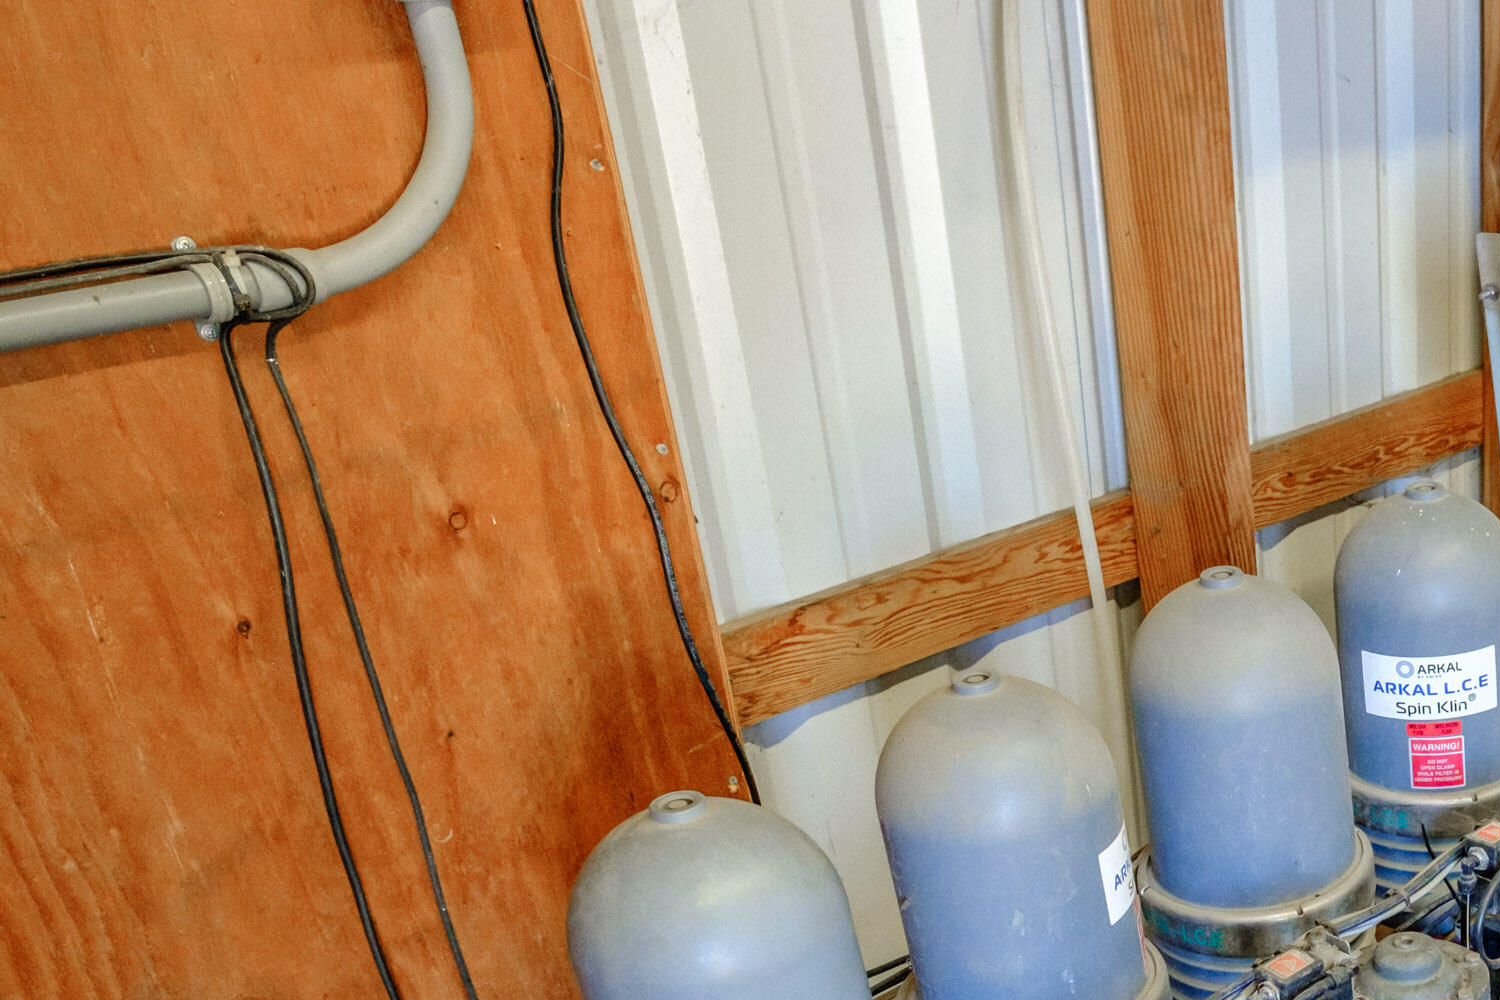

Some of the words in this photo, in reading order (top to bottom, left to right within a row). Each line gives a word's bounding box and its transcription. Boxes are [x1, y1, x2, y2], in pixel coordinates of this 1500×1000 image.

[1417, 661, 1463, 675] ARKAL
[1373, 680, 1438, 696] ARKAL
[1444, 674, 1489, 694] L.C.E
[1396, 702, 1432, 717] Spin
[1412, 742, 1460, 751] WARNING!
